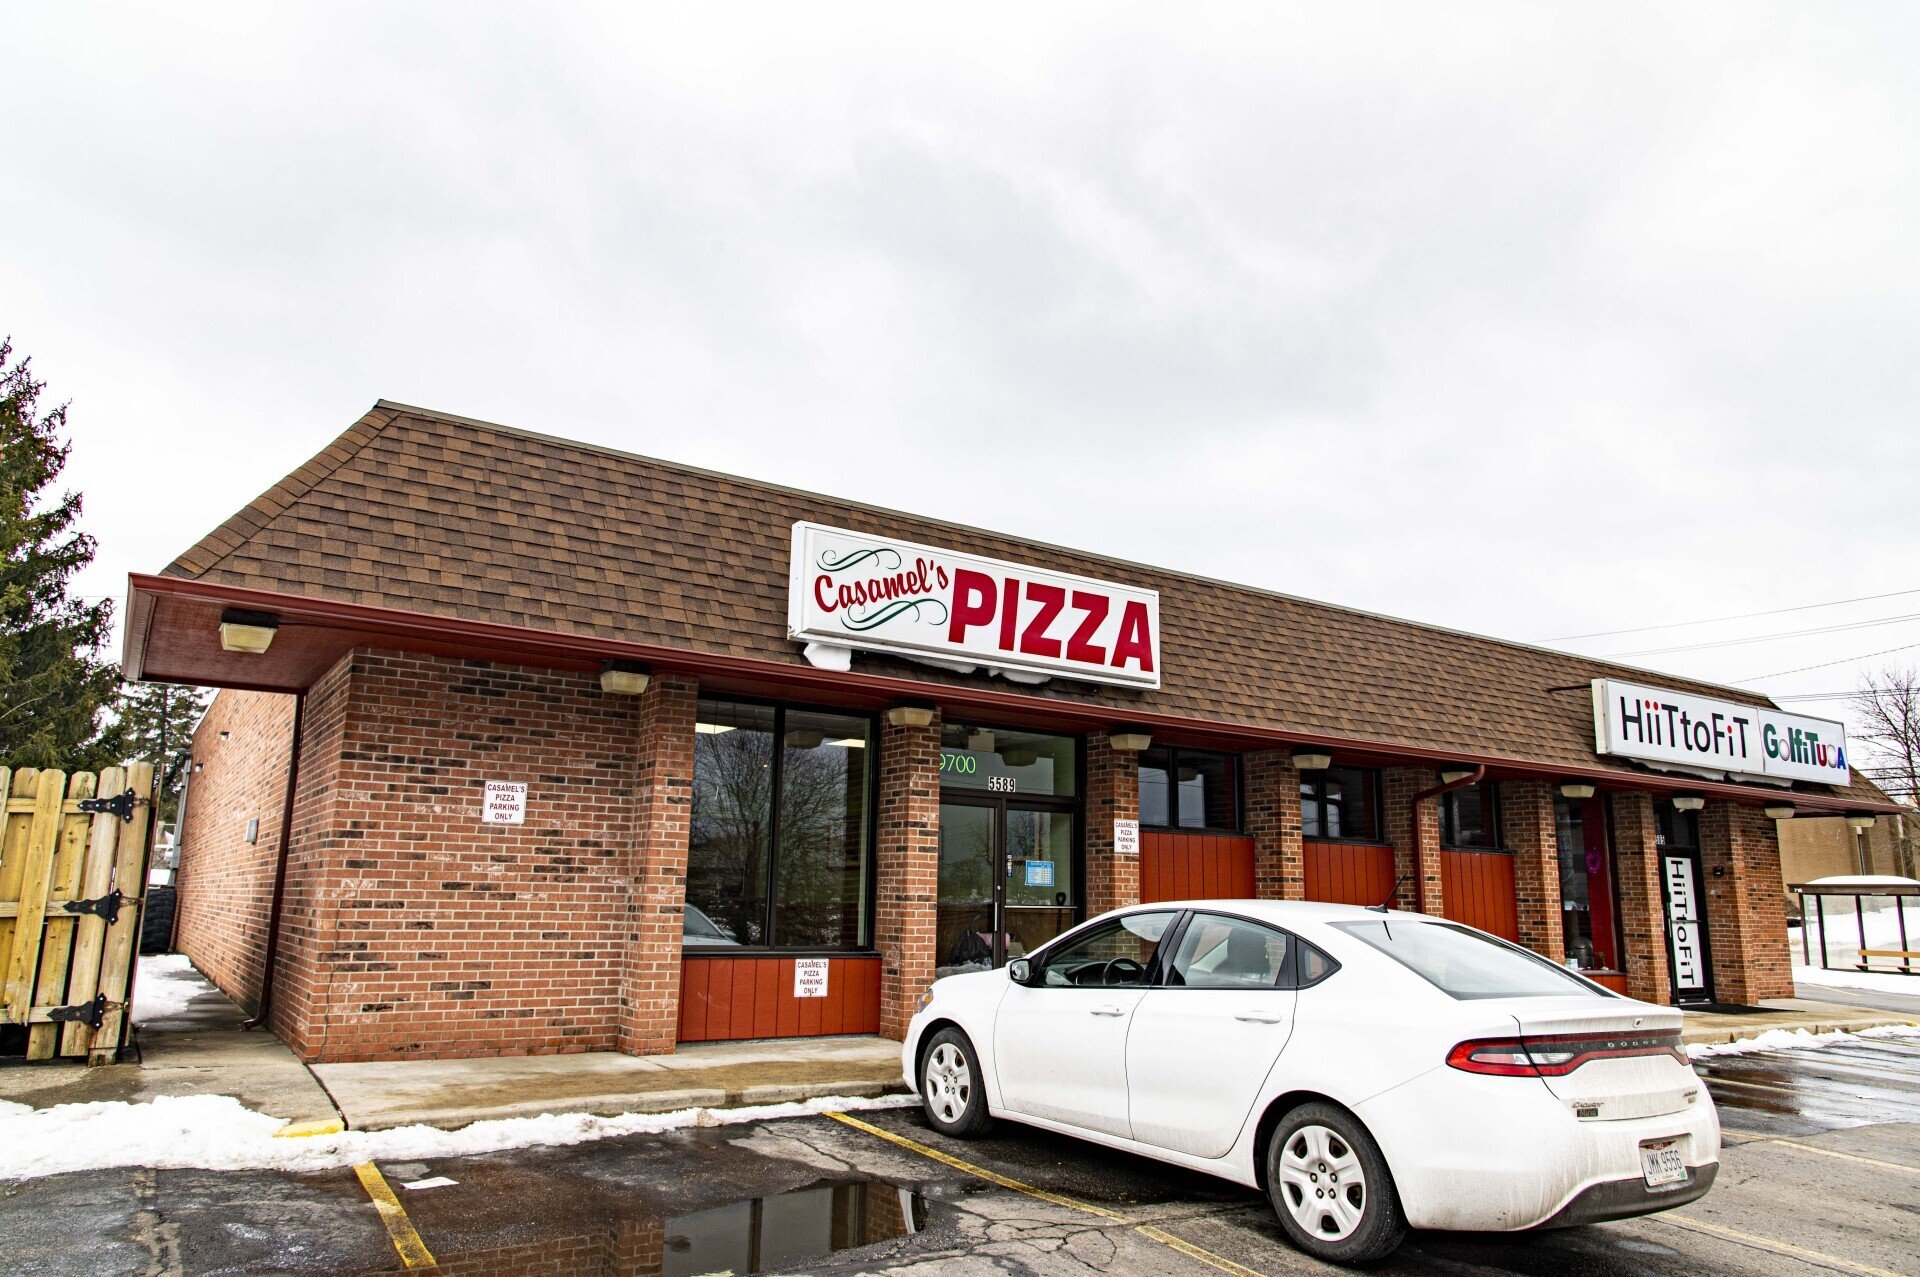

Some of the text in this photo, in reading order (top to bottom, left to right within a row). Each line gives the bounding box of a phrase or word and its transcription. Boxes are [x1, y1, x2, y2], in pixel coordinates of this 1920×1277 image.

[814, 557, 1154, 673] Casamel's PIZZA
[487, 784, 525, 793] CASAMEL'S
[989, 776, 1015, 792] 5589
[495, 793, 515, 802] PIZZA
[489, 802, 520, 812] PARKING
[494, 812, 513, 820] ONLY
[797, 961, 827, 969] CASAMEL'S
[799, 978, 823, 986] PARKING
[1660, 1149, 1683, 1172] 9556
